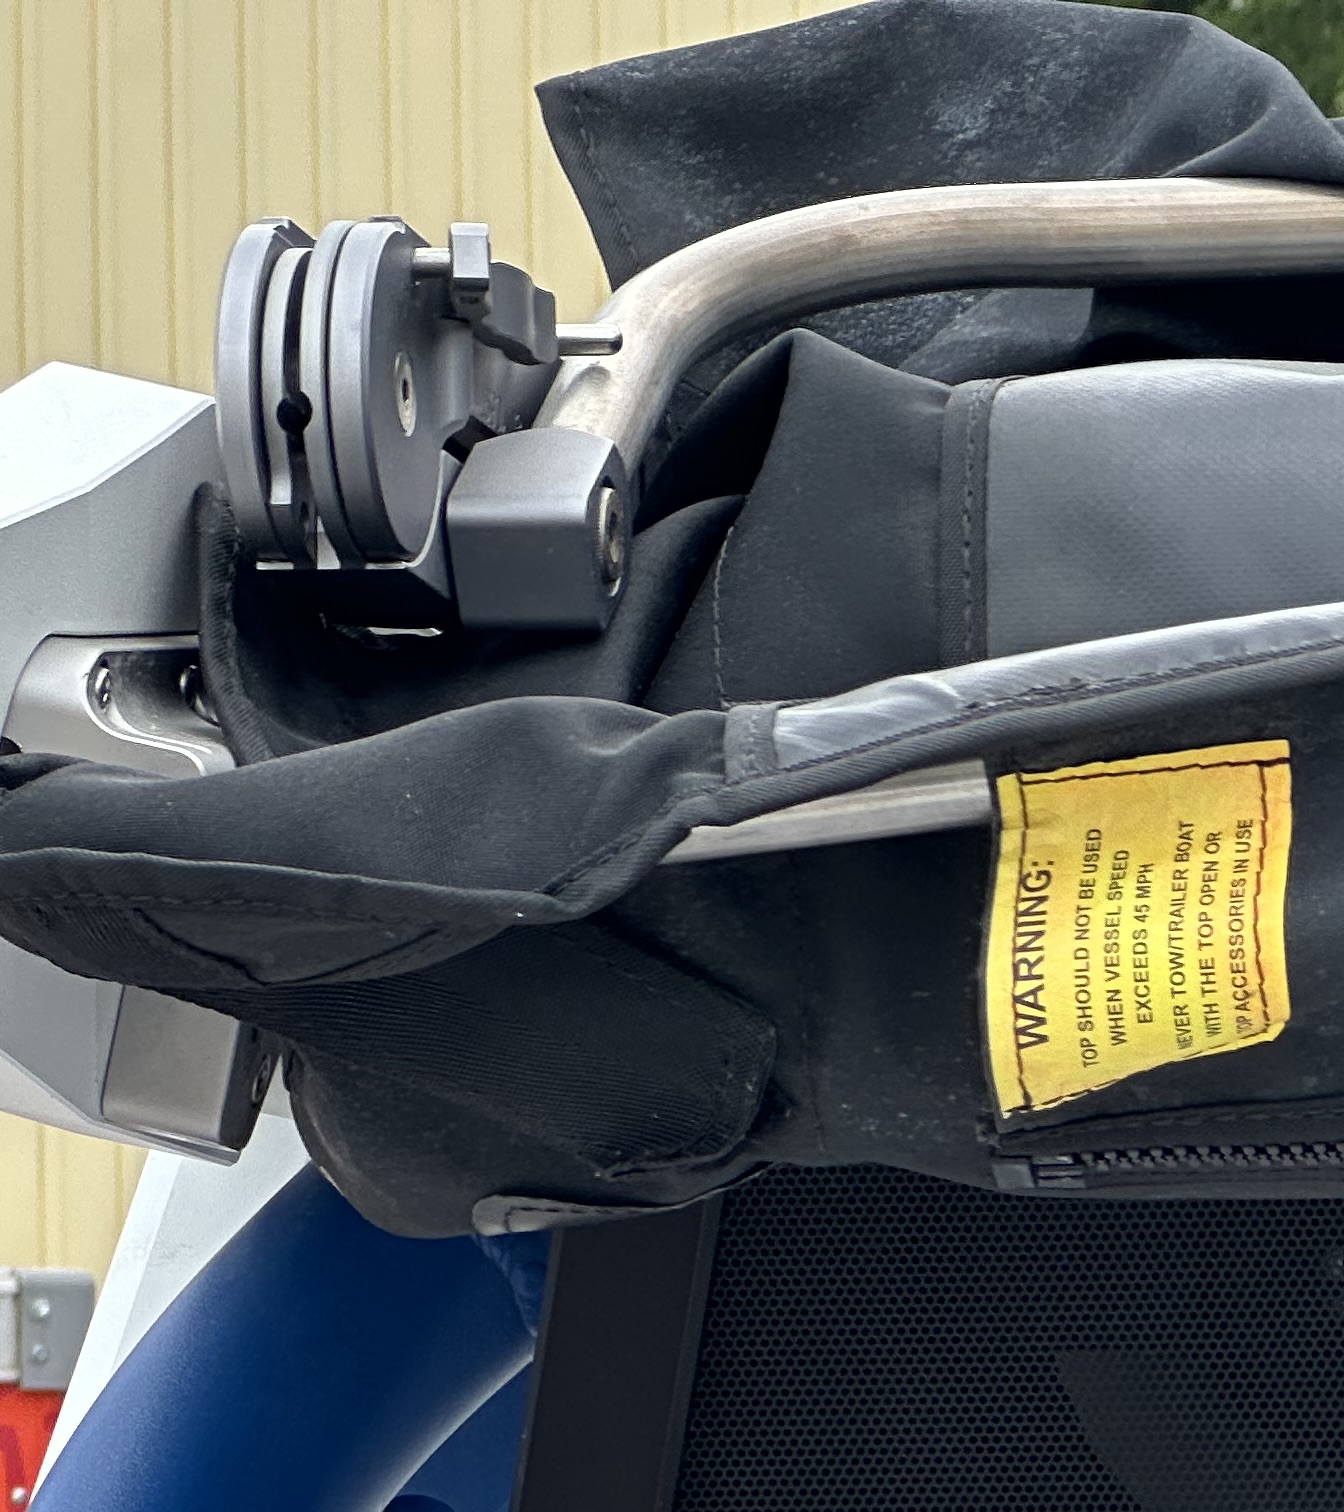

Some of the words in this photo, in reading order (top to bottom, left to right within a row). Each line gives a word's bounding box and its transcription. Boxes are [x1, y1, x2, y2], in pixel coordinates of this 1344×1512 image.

[1080, 829, 1102, 874] USED
[1172, 820, 1194, 862] BOAT
[1204, 832, 1222, 854] OR
[1234, 819, 1253, 854] USE
[1106, 850, 1129, 900] SPEED
[1135, 863, 1154, 899] MPH
[1199, 861, 1219, 906] OPEN
[1232, 858, 1250, 874] IN
[1078, 878, 1095, 899] BE
[1074, 905, 1092, 940] NOT
[1133, 904, 1150, 923] 45
[1168, 868, 1189, 999] TOW/TRAILER
[1197, 912, 1213, 951] TOP
[1013, 861, 1054, 1050] WARNING:
[1104, 906, 1121, 982] VESSEL
[1228, 878, 1251, 1012] ACCESSORIES
[1074, 948, 1094, 1032] SHOULD
[1132, 929, 1153, 1024] EXCEEDS
[1198, 958, 1218, 998] THE
[1105, 989, 1127, 1046] WHEN
[1172, 1004, 1193, 1050] NEVER
[1202, 1003, 1222, 1037] WITH
[1080, 1038, 1100, 1068] TOP
